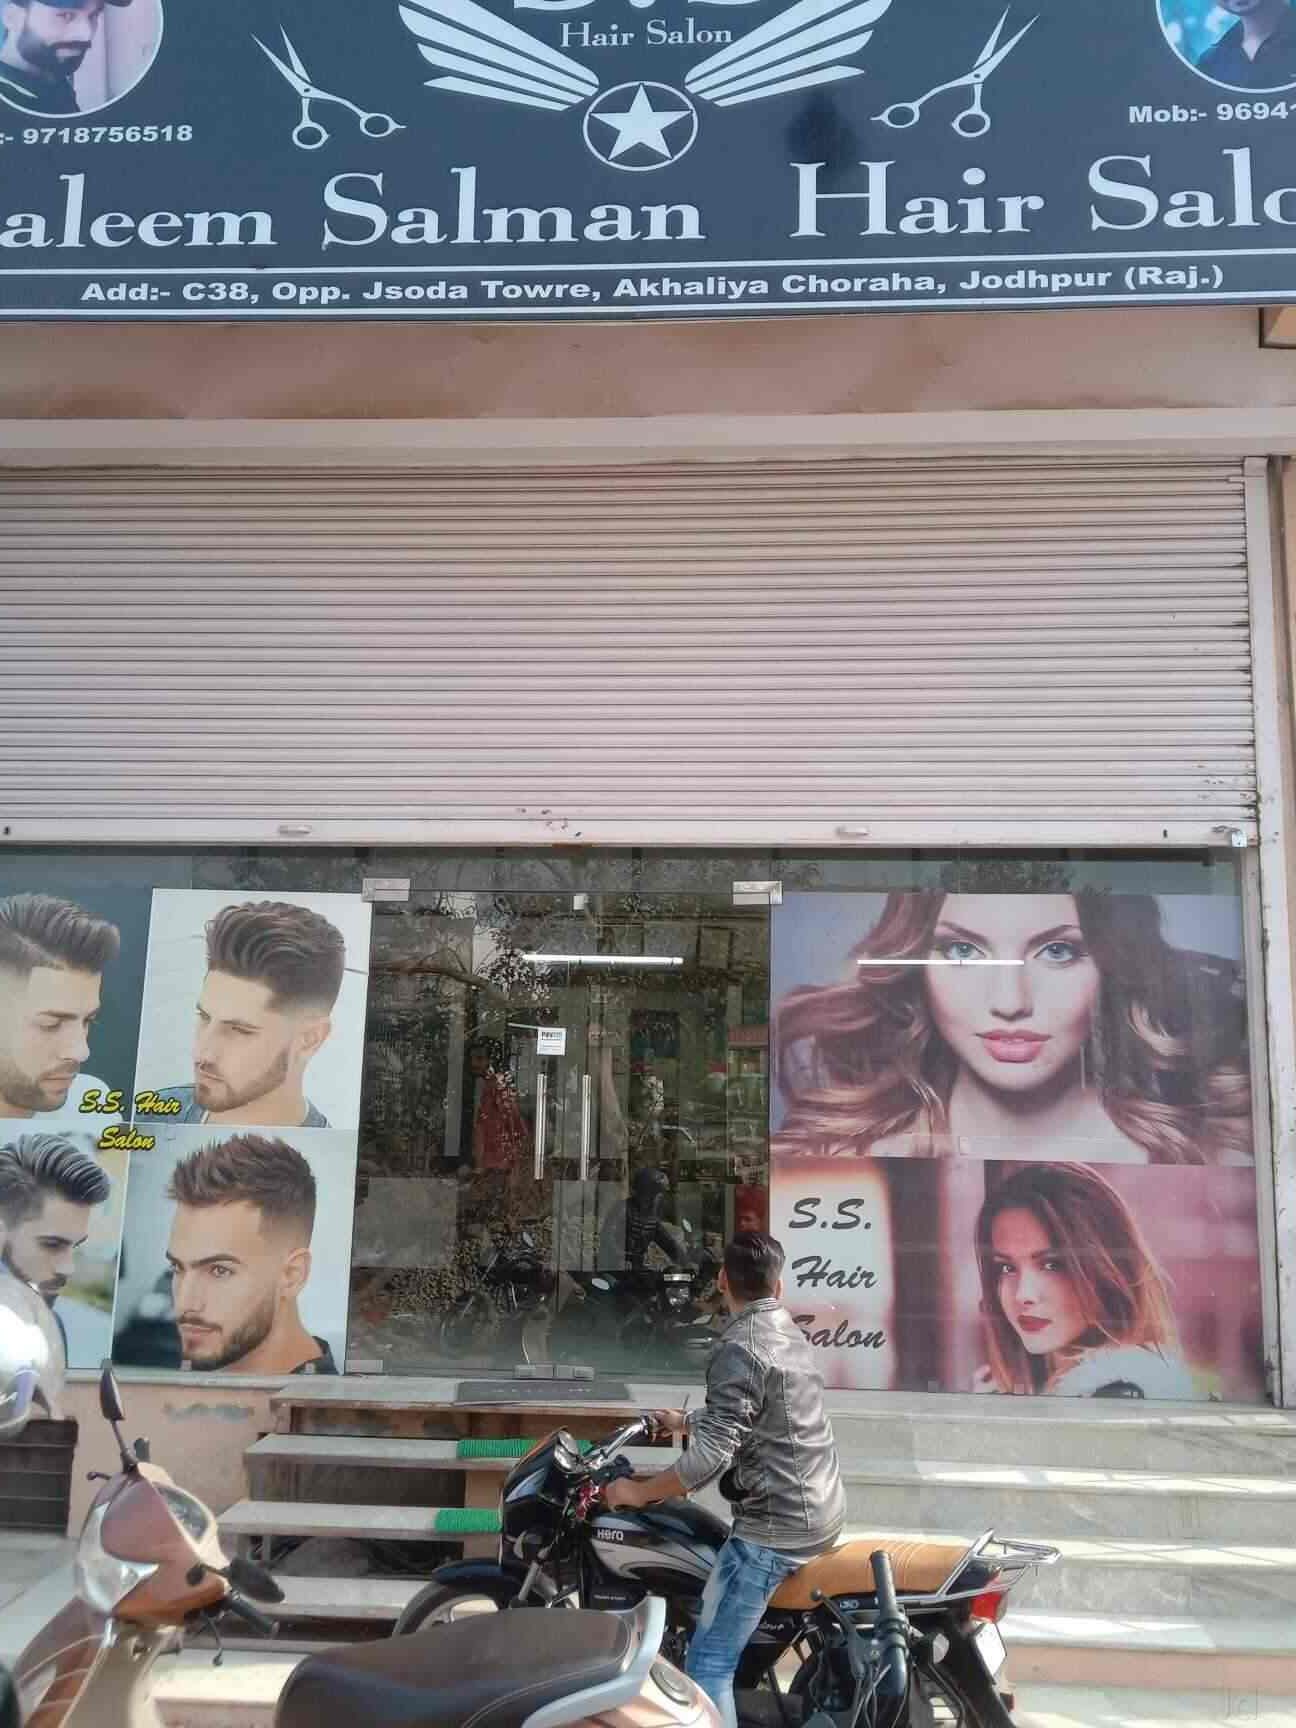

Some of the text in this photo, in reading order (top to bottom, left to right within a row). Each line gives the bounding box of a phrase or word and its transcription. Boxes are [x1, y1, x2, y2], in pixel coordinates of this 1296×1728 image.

[560, 17, 734, 48] Hair Salon
[1128, 104, 1208, 124] Mob:-
[22, 125, 194, 145] 9718756518
[320, 166, 706, 251] Salman
[789, 160, 1046, 238] Hair
[80, 263, 1226, 305] Add:- C38, Opp. Jsoda Towre, Akhaliya Choraha, Jodhpur (Raj.)
[79, 1088, 181, 1115] S.S. Hair
[97, 1125, 155, 1150] Salon
[788, 1197, 872, 1230] S.S.
[791, 1255, 878, 1289] Hair
